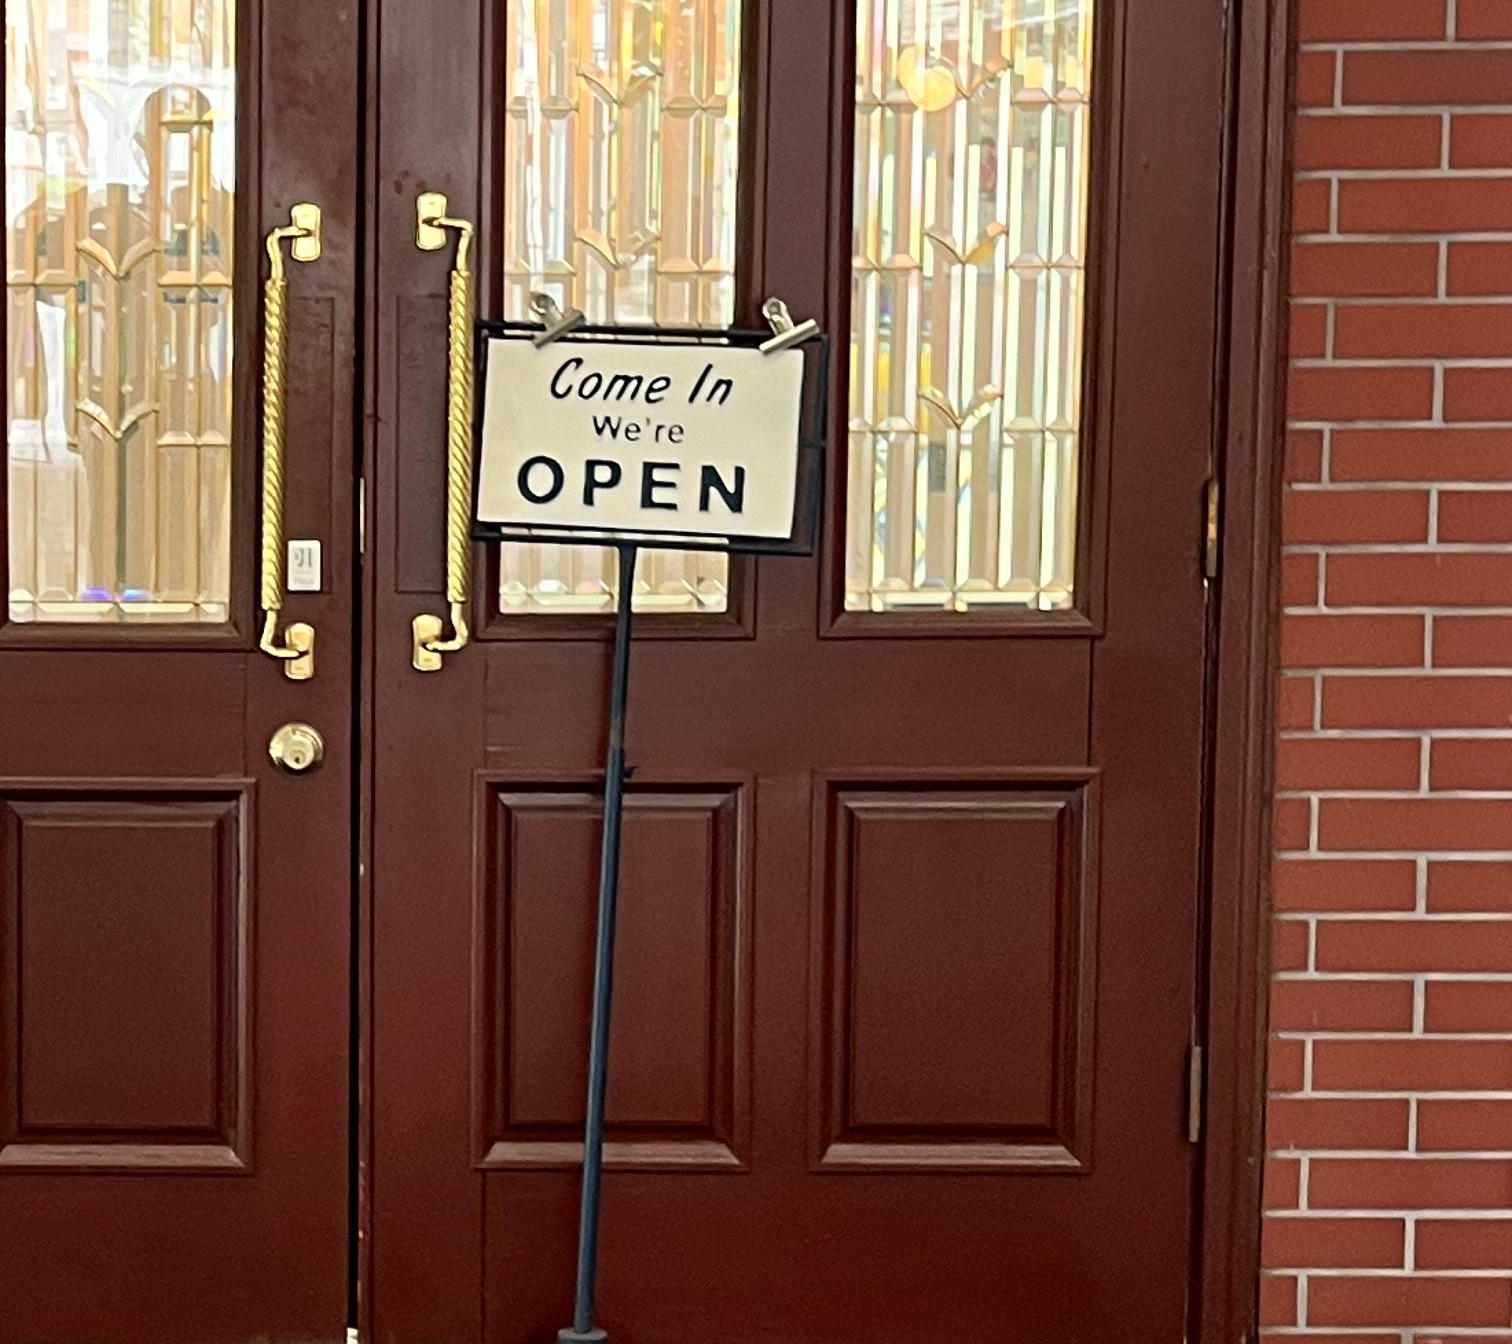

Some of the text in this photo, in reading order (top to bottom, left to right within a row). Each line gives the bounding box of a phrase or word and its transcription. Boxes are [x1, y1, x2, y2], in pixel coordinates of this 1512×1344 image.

[550, 357, 734, 406] Come In
[592, 415, 684, 444] We're
[517, 455, 746, 515] OPEN
